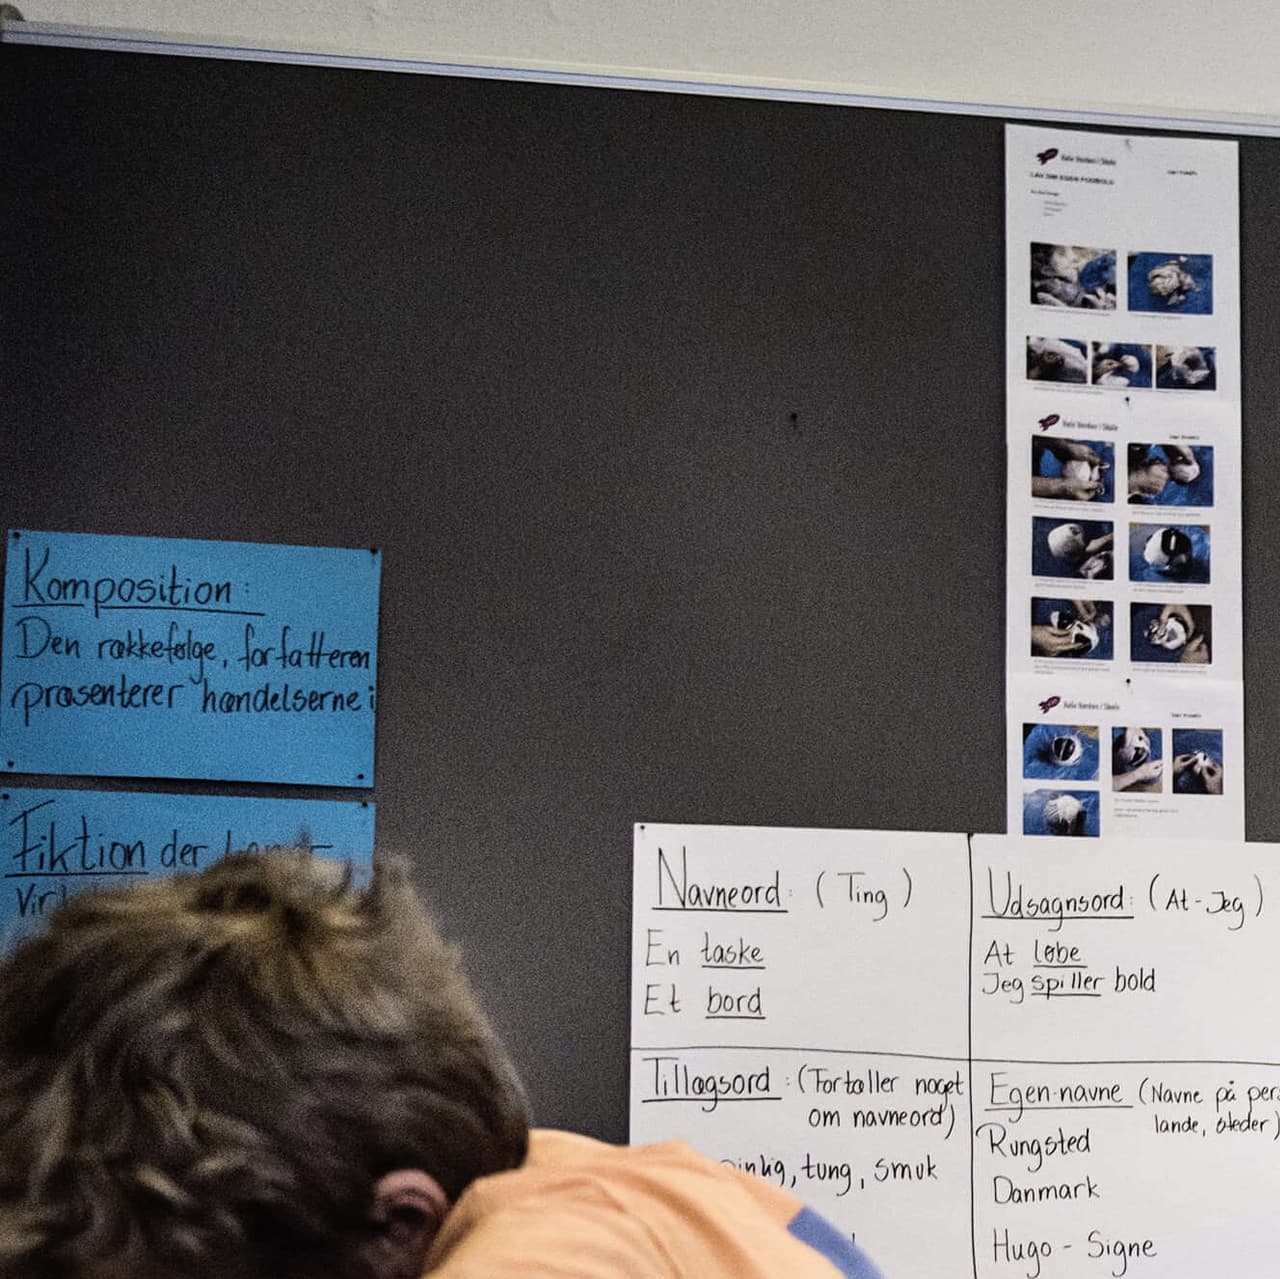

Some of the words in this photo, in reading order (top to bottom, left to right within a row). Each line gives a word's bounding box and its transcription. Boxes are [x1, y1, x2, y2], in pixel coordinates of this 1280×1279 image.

[16, 616, 81, 659] Den
[9, 800, 146, 872] Fiktion
[160, 829, 208, 868] der
[646, 929, 680, 966] En
[701, 931, 764, 965] taske
[984, 940, 1015, 967] At
[1034, 939, 1080, 964] løbe
[644, 984, 681, 1015] Et
[706, 986, 762, 1014] bord
[982, 972, 1024, 1003] Jeg
[1031, 971, 1105, 1000] spiller
[1115, 966, 1156, 992] bold
[914, 1070, 964, 1112] noget
[1139, 1077, 1203, 1105] (Navne
[1216, 1080, 1237, 1112] på
[808, 1108, 840, 1127] om
[853, 1105, 956, 1140] navneord)
[1154, 1114, 1206, 1137] lande,
[801, 1152, 865, 1196] tung,
[994, 1176, 1100, 1204] Danmark
[994, 1228, 1051, 1279] Hugo
[1088, 1230, 1158, 1278] Signe
